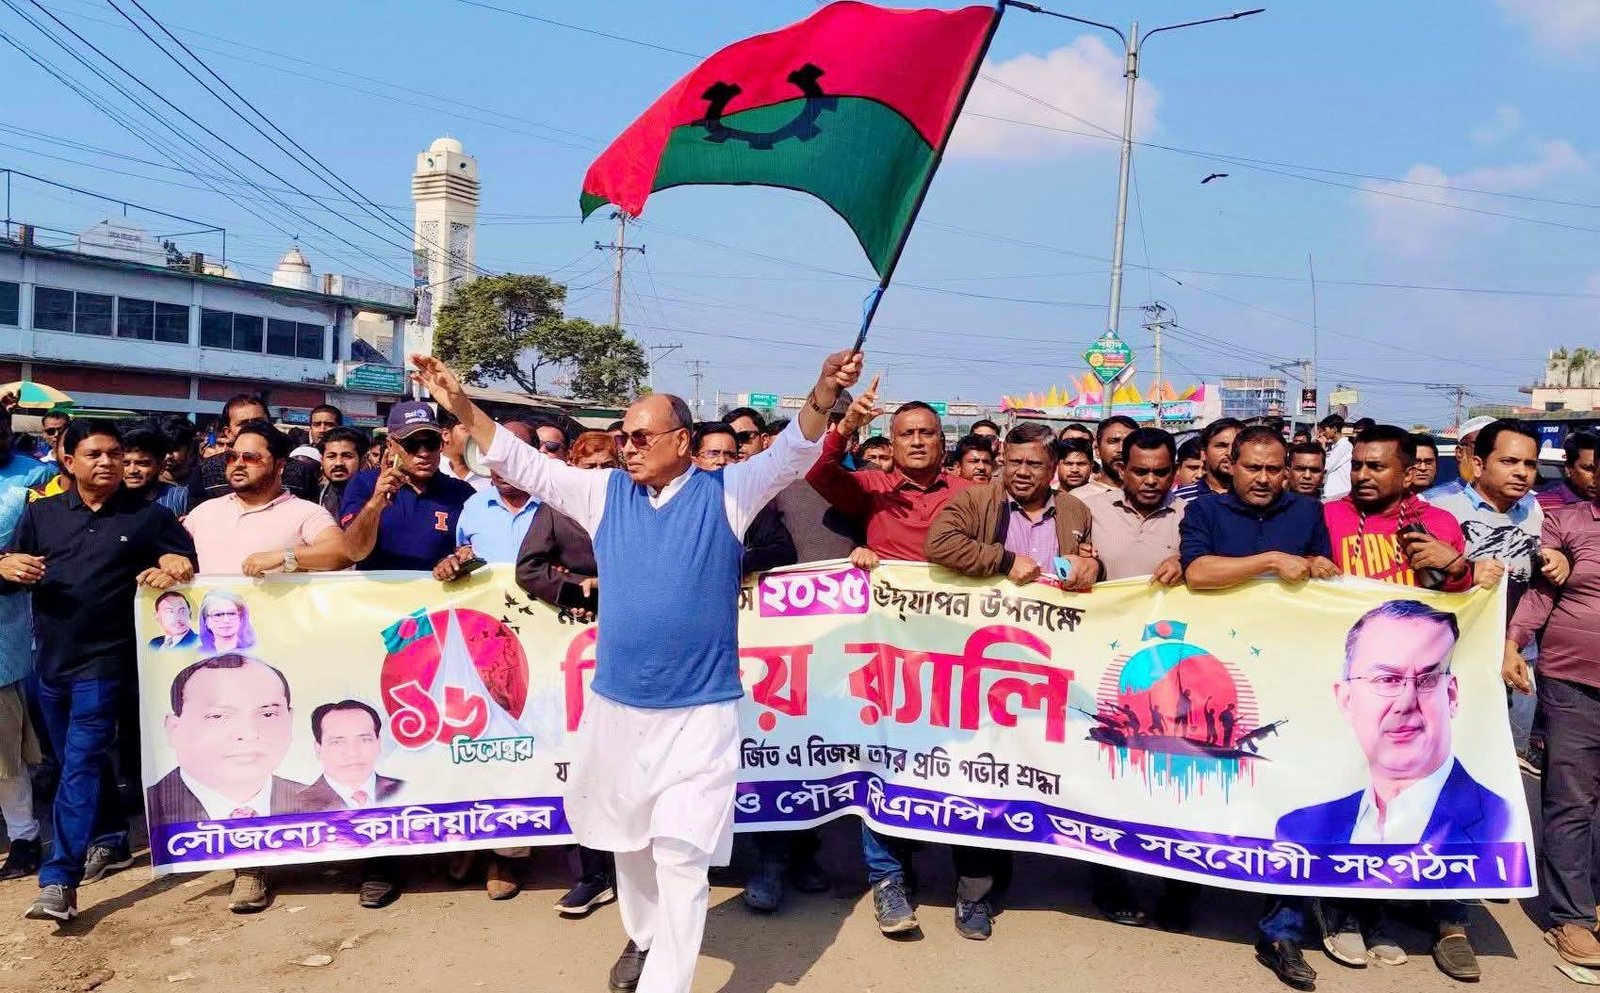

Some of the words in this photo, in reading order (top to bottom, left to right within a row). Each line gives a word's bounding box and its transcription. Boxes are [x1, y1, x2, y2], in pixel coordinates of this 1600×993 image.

[763, 572, 866, 612] ২০২৫
[980, 589, 1086, 632] উপলক্ষে
[389, 679, 491, 751] ১৬
[844, 624, 1075, 743] র‍্যালি
[449, 733, 535, 764] ডিসেম্বর
[786, 744, 802, 767] এ
[806, 734, 861, 767] বিজয়
[912, 745, 952, 780] প্রতি
[959, 752, 1010, 789] গভীর
[1016, 763, 1062, 795] শ্রদ্ধা
[350, 802, 556, 845] কালিয়াকৈর
[735, 792, 762, 814] ও
[776, 780, 860, 814] পৌর
[867, 776, 992, 831] বিএনপি
[1004, 811, 1035, 833] ও
[1045, 812, 1127, 852] অঙ্গ
[1135, 832, 1321, 880] সহযোগী
[1329, 844, 1480, 884] সংগঠন
